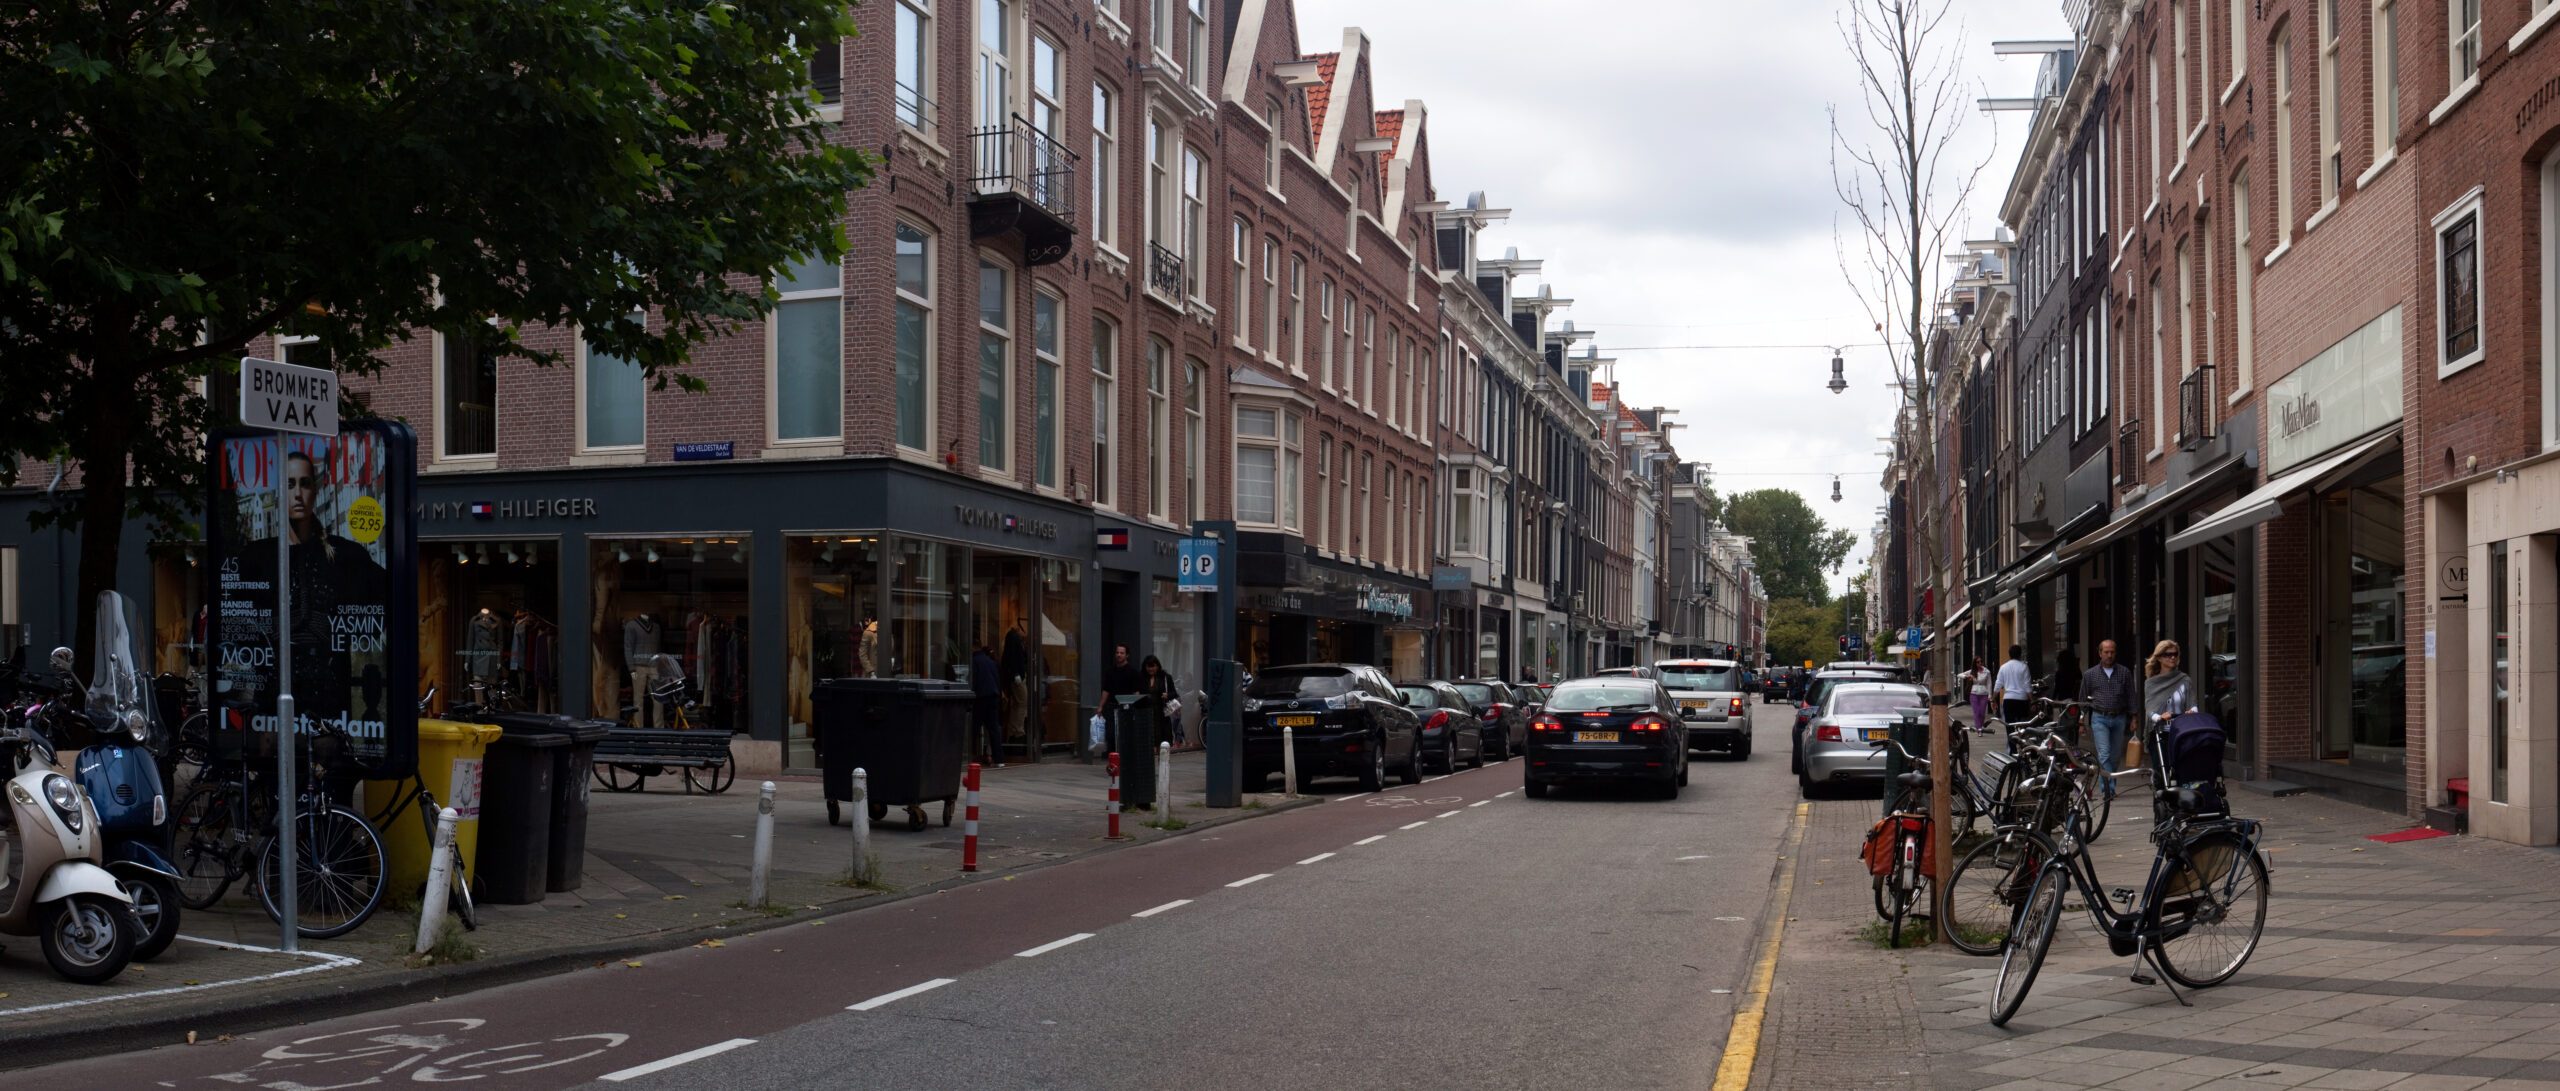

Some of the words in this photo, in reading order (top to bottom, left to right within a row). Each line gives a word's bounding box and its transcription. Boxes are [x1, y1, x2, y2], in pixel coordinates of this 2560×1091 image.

[254, 368, 328, 402] BROMMER
[267, 398, 317, 428] VAK
[501, 498, 597, 517] HILFIGER
[350, 517, 381, 532] €2,95
[955, 504, 1003, 530] TOMMY
[1018, 516, 1057, 539] HILFIGER
[220, 557, 239, 574] 45
[1201, 557, 1211, 573] P
[220, 574, 240, 582] BESTE
[220, 582, 270, 590] HERFSTTRENDS
[220, 601, 254, 609] HANDIGE
[220, 609, 257, 617] SHOPPING
[259, 609, 272, 617] LIST
[337, 604, 385, 615] SUPERMODEL
[327, 615, 384, 634] YASMIN
[331, 634, 345, 652] LE
[350, 634, 383, 653] BON
[222, 646, 274, 667] MODE
[1580, 732, 1616, 740] 75-GBR-7
